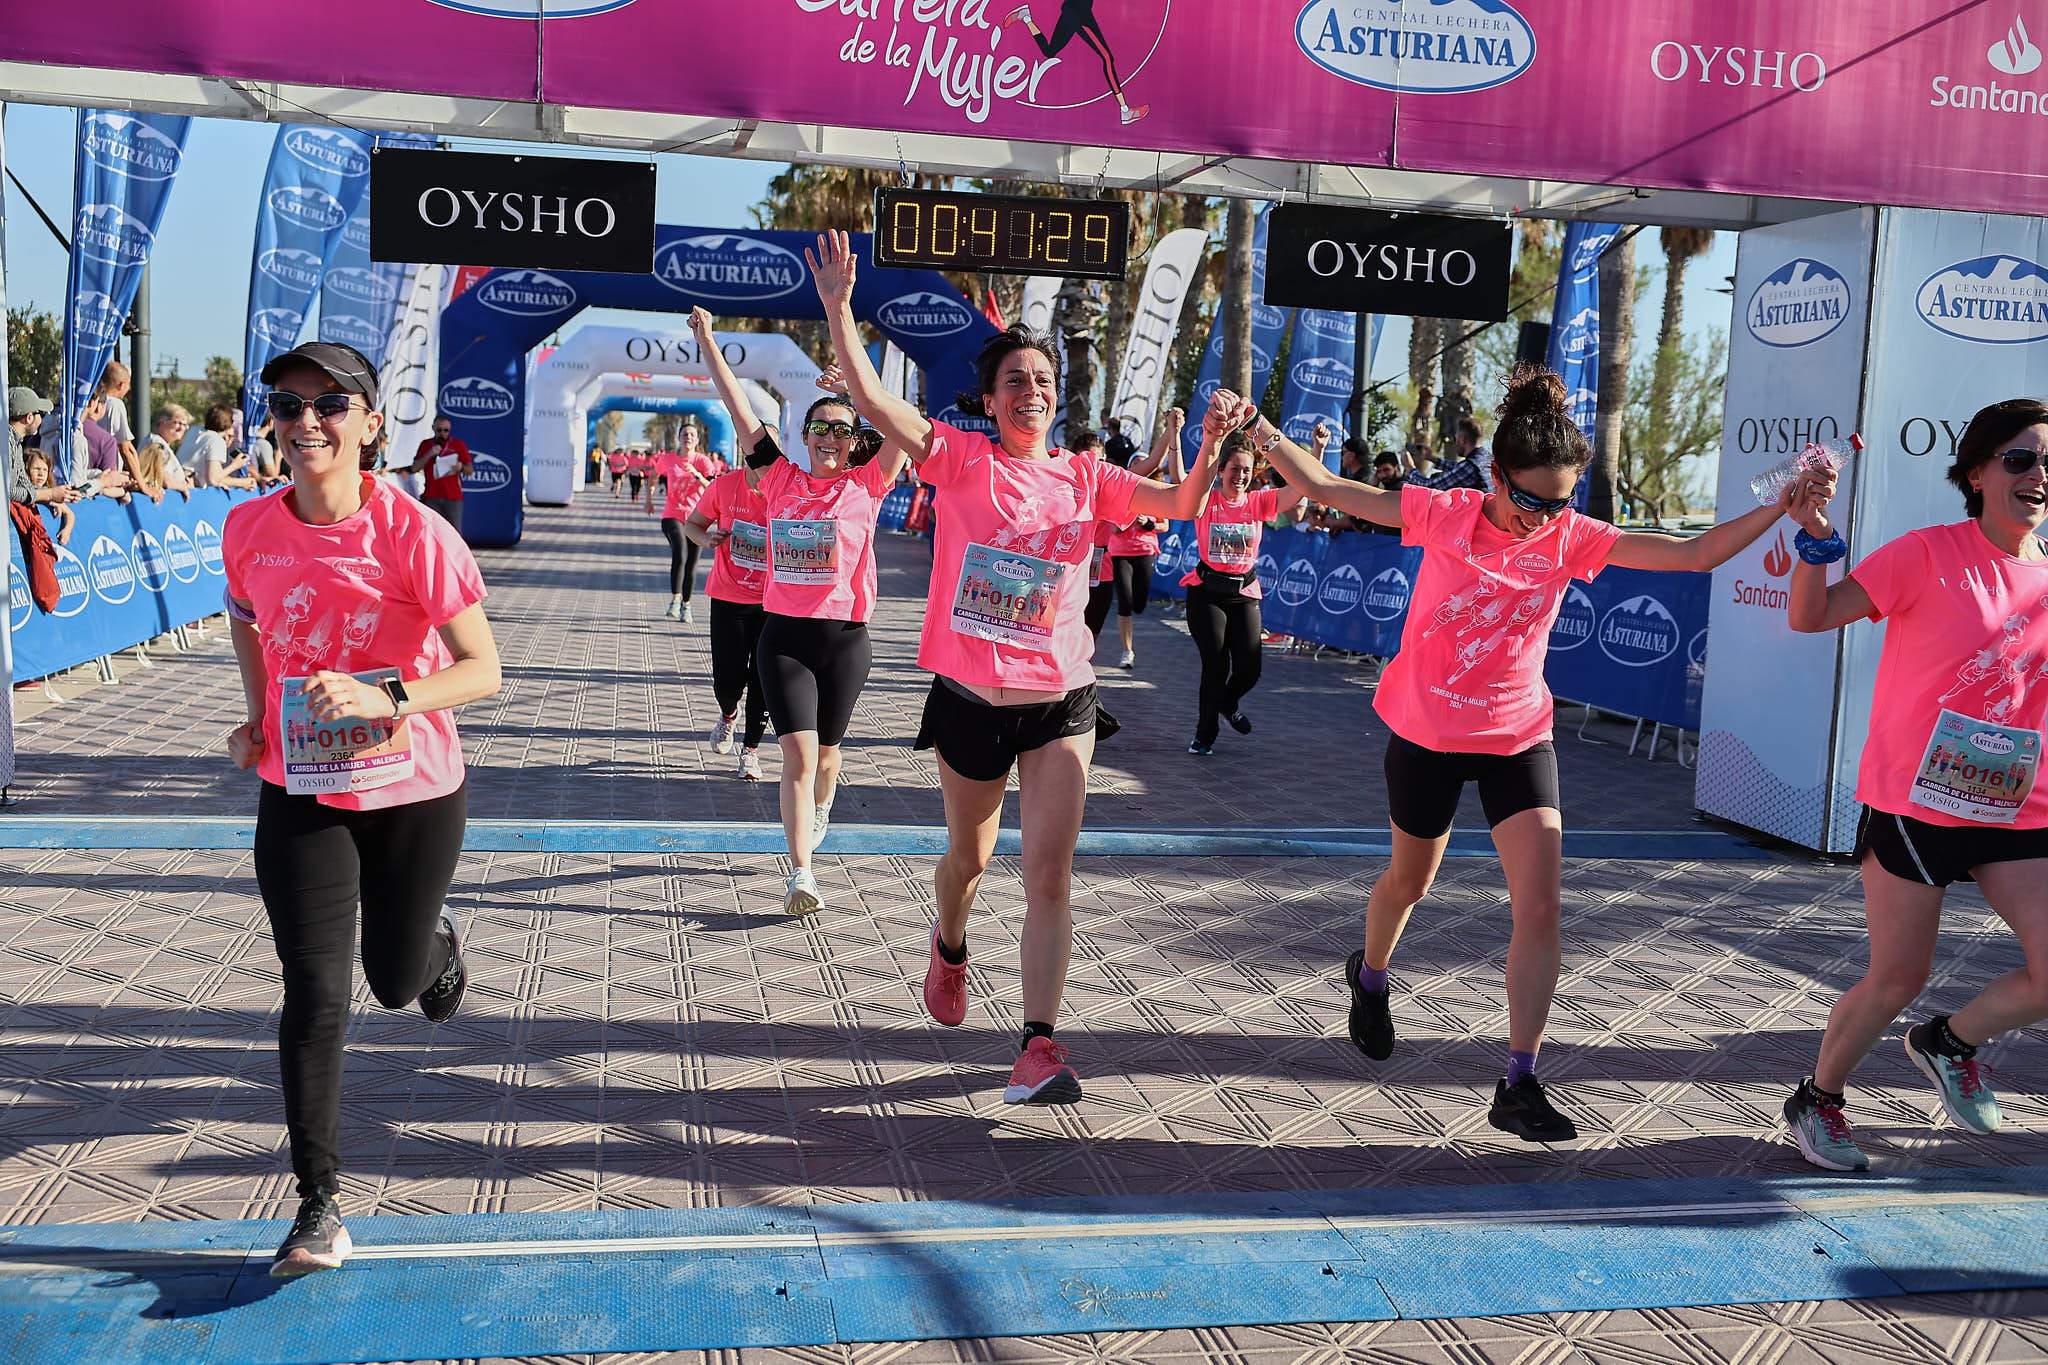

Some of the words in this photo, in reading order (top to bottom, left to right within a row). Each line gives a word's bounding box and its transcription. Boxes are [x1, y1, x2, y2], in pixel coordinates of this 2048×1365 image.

[1352, 7, 1428, 25] CENTRAL
[1435, 14, 1512, 32] LECHERA
[1314, 8, 1517, 67] ASTURIANA
[839, 21, 877, 63] de
[884, 24, 912, 67] la
[904, 25, 1062, 124] Mujer
[1650, 41, 1828, 92] OYSHO
[289, 138, 365, 174] ASTURIANA
[418, 187, 616, 238] OYSHO
[893, 202, 1110, 263] 00:41:29
[662, 251, 794, 286] ASTURIANA
[1307, 239, 1477, 287] OYSHO
[483, 284, 568, 306] ASTURIANA
[1954, 283, 2007, 295] CENTRAL
[886, 302, 967, 327] ASTURIANA
[1751, 295, 1841, 328] ASTURIANA
[442, 391, 510, 411] ASTURIANA
[1738, 416, 1839, 455] OYSHO
[745, 543, 765, 553] 016
[790, 548, 816, 560] 016
[994, 562, 1032, 579] ASTURIANA
[989, 590, 1027, 611] 016
[1733, 579, 1790, 610] Santan
[957, 609, 982, 621] CARRERA
[982, 614, 991, 622] DE
[991, 617, 998, 625] LA
[998, 618, 1018, 629] MUJER
[1021, 623, 1047, 636] VALENCIA
[960, 621, 992, 635] OYSHO
[1602, 616, 1669, 653] ASTURIANA
[1430, 685, 1452, 700] CARRERA
[1452, 690, 1461, 700] DE
[1460, 692, 1468, 704] LA
[1468, 694, 1488, 708] MUJER
[1449, 700, 1463, 710] 2024
[318, 725, 369, 748] 016
[291, 764, 319, 773] CARRERA
[319, 763, 329, 773] DE
[329, 763, 340, 772] LA
[340, 760, 366, 771] MUJER
[372, 753, 406, 766] VALENCIA
[330, 750, 355, 762] 2364
[298, 777, 336, 789] OYSHO
[1962, 764, 2005, 787] 016
[1921, 780, 1951, 795] CARRERA
[1950, 789, 1960, 798] DE
[1960, 792, 1970, 802] LA
[1923, 791, 1960, 810] OYSHO
